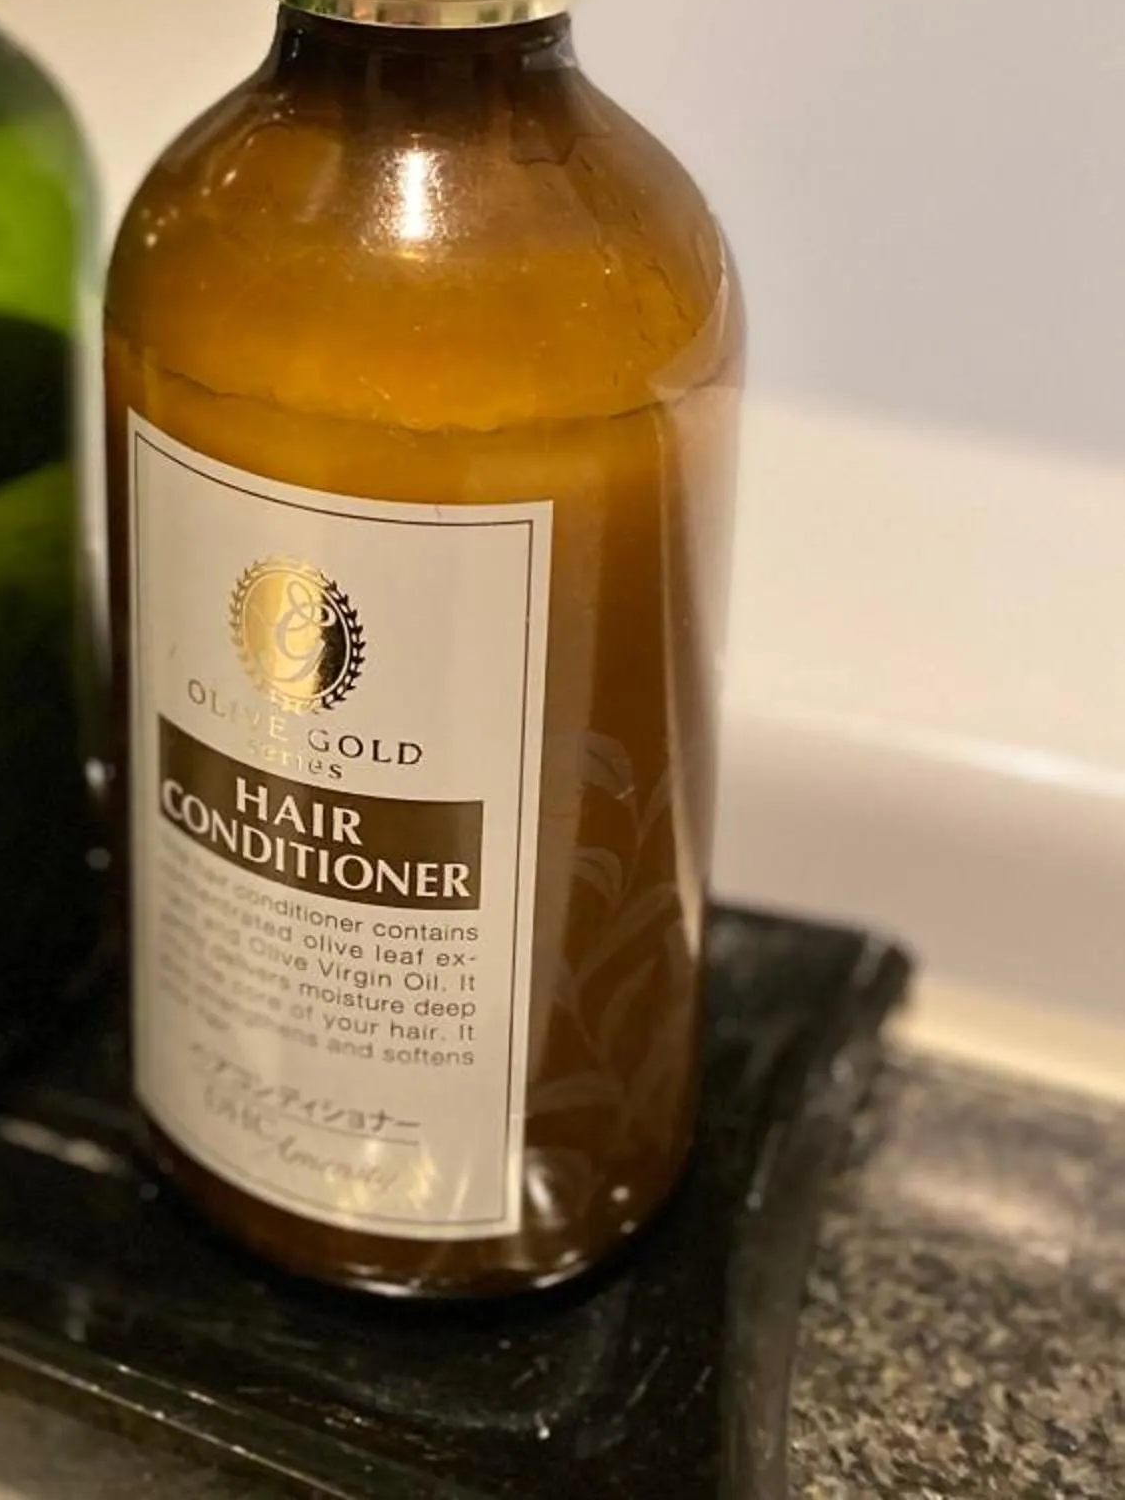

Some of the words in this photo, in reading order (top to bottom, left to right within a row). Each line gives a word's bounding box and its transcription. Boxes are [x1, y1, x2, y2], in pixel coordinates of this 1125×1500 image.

[188, 678, 289, 743] OLIVE
[308, 727, 424, 766] GOLD
[161, 778, 472, 898] CONDITIONER
[235, 776, 364, 847] HAIR
[233, 885, 364, 934] conditioner
[372, 921, 480, 942] contains
[248, 935, 309, 971] Olive
[317, 958, 393, 990] Virgin
[404, 971, 447, 993] Oil.
[460, 973, 476, 992] It
[303, 933, 364, 960] olive
[375, 944, 424, 966] leaf
[436, 952, 477, 968] ex-
[290, 1003, 314, 1021] of
[322, 1012, 380, 1036] your
[390, 1019, 447, 1042] hair.
[459, 1024, 475, 1042] It
[299, 982, 405, 1015] moisture
[414, 999, 476, 1020] deep
[326, 1036, 374, 1060] and
[381, 1046, 475, 1067] softens
